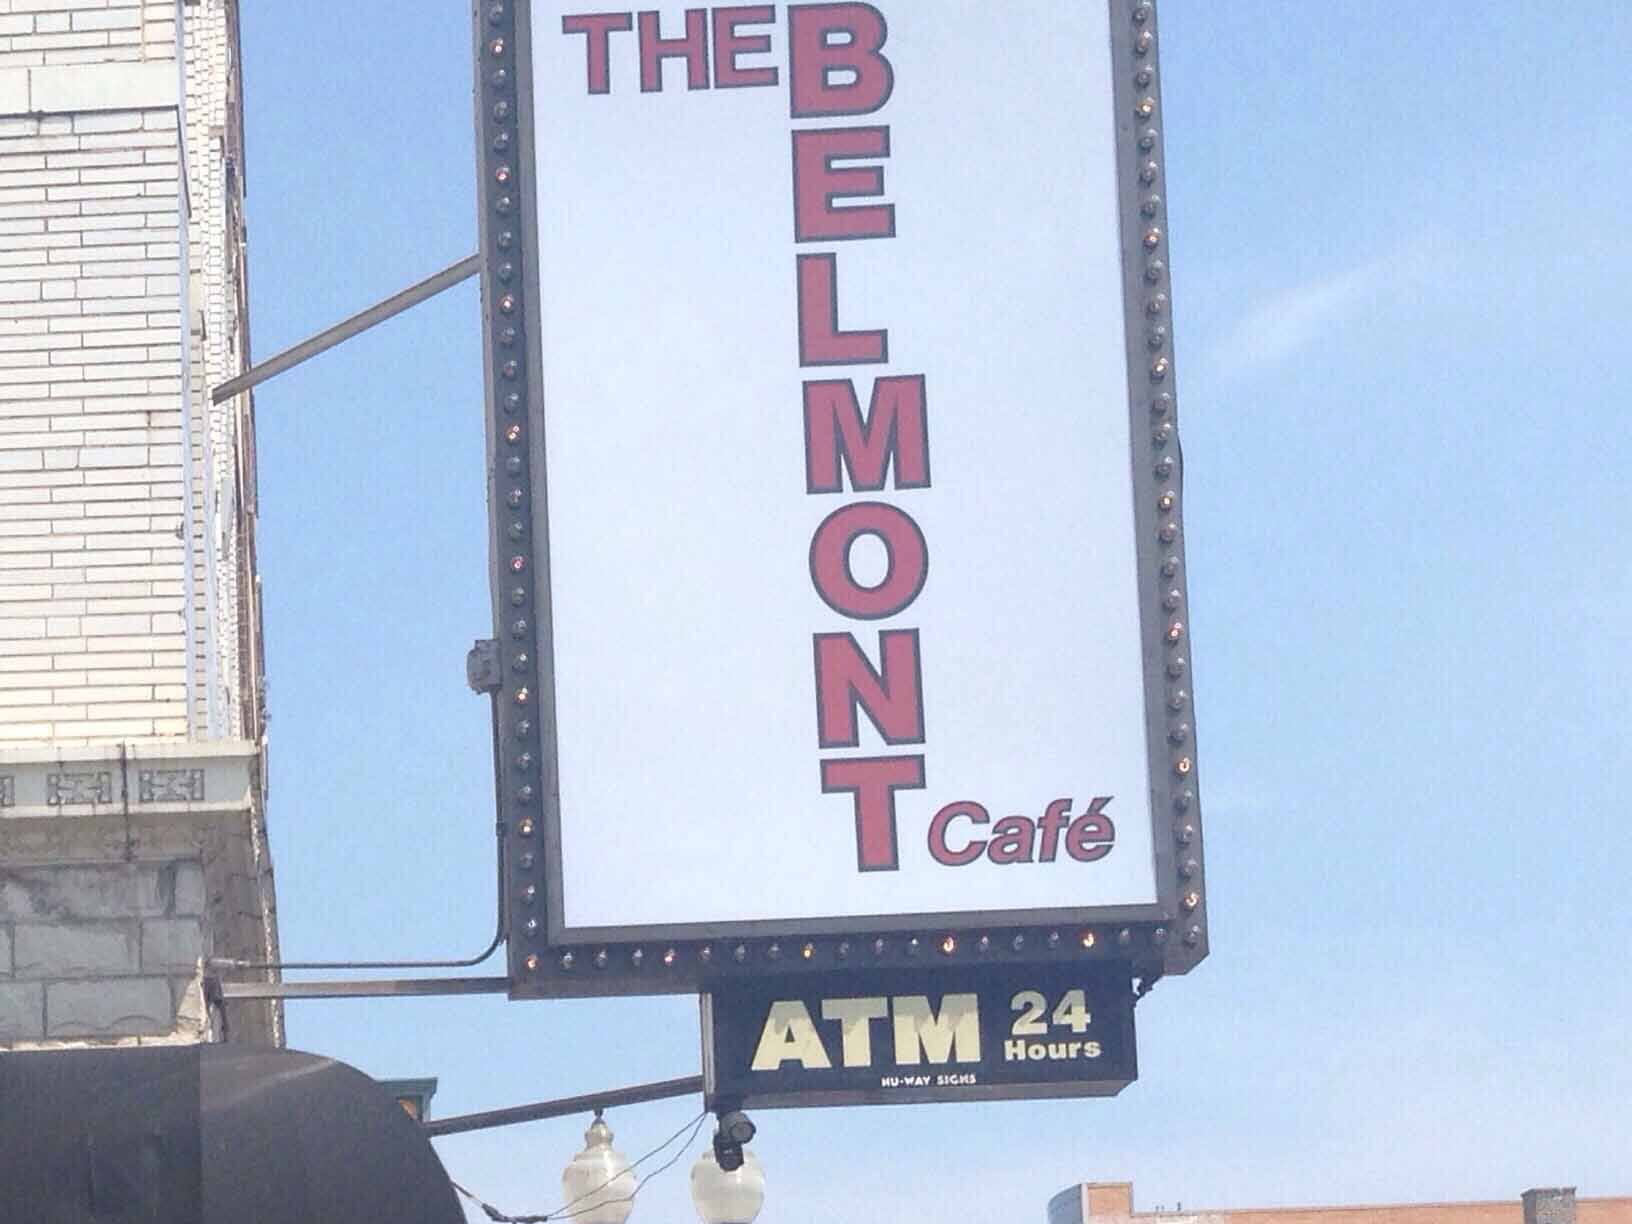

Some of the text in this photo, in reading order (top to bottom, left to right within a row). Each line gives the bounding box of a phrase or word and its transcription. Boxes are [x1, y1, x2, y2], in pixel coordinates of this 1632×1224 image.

[561, 4, 780, 95] THE
[786, 1, 932, 873] BELMONT
[927, 795, 1116, 867] Café
[751, 994, 981, 1071] ATM
[1010, 989, 1092, 1036] 24
[1004, 1038, 1103, 1062] Hours
